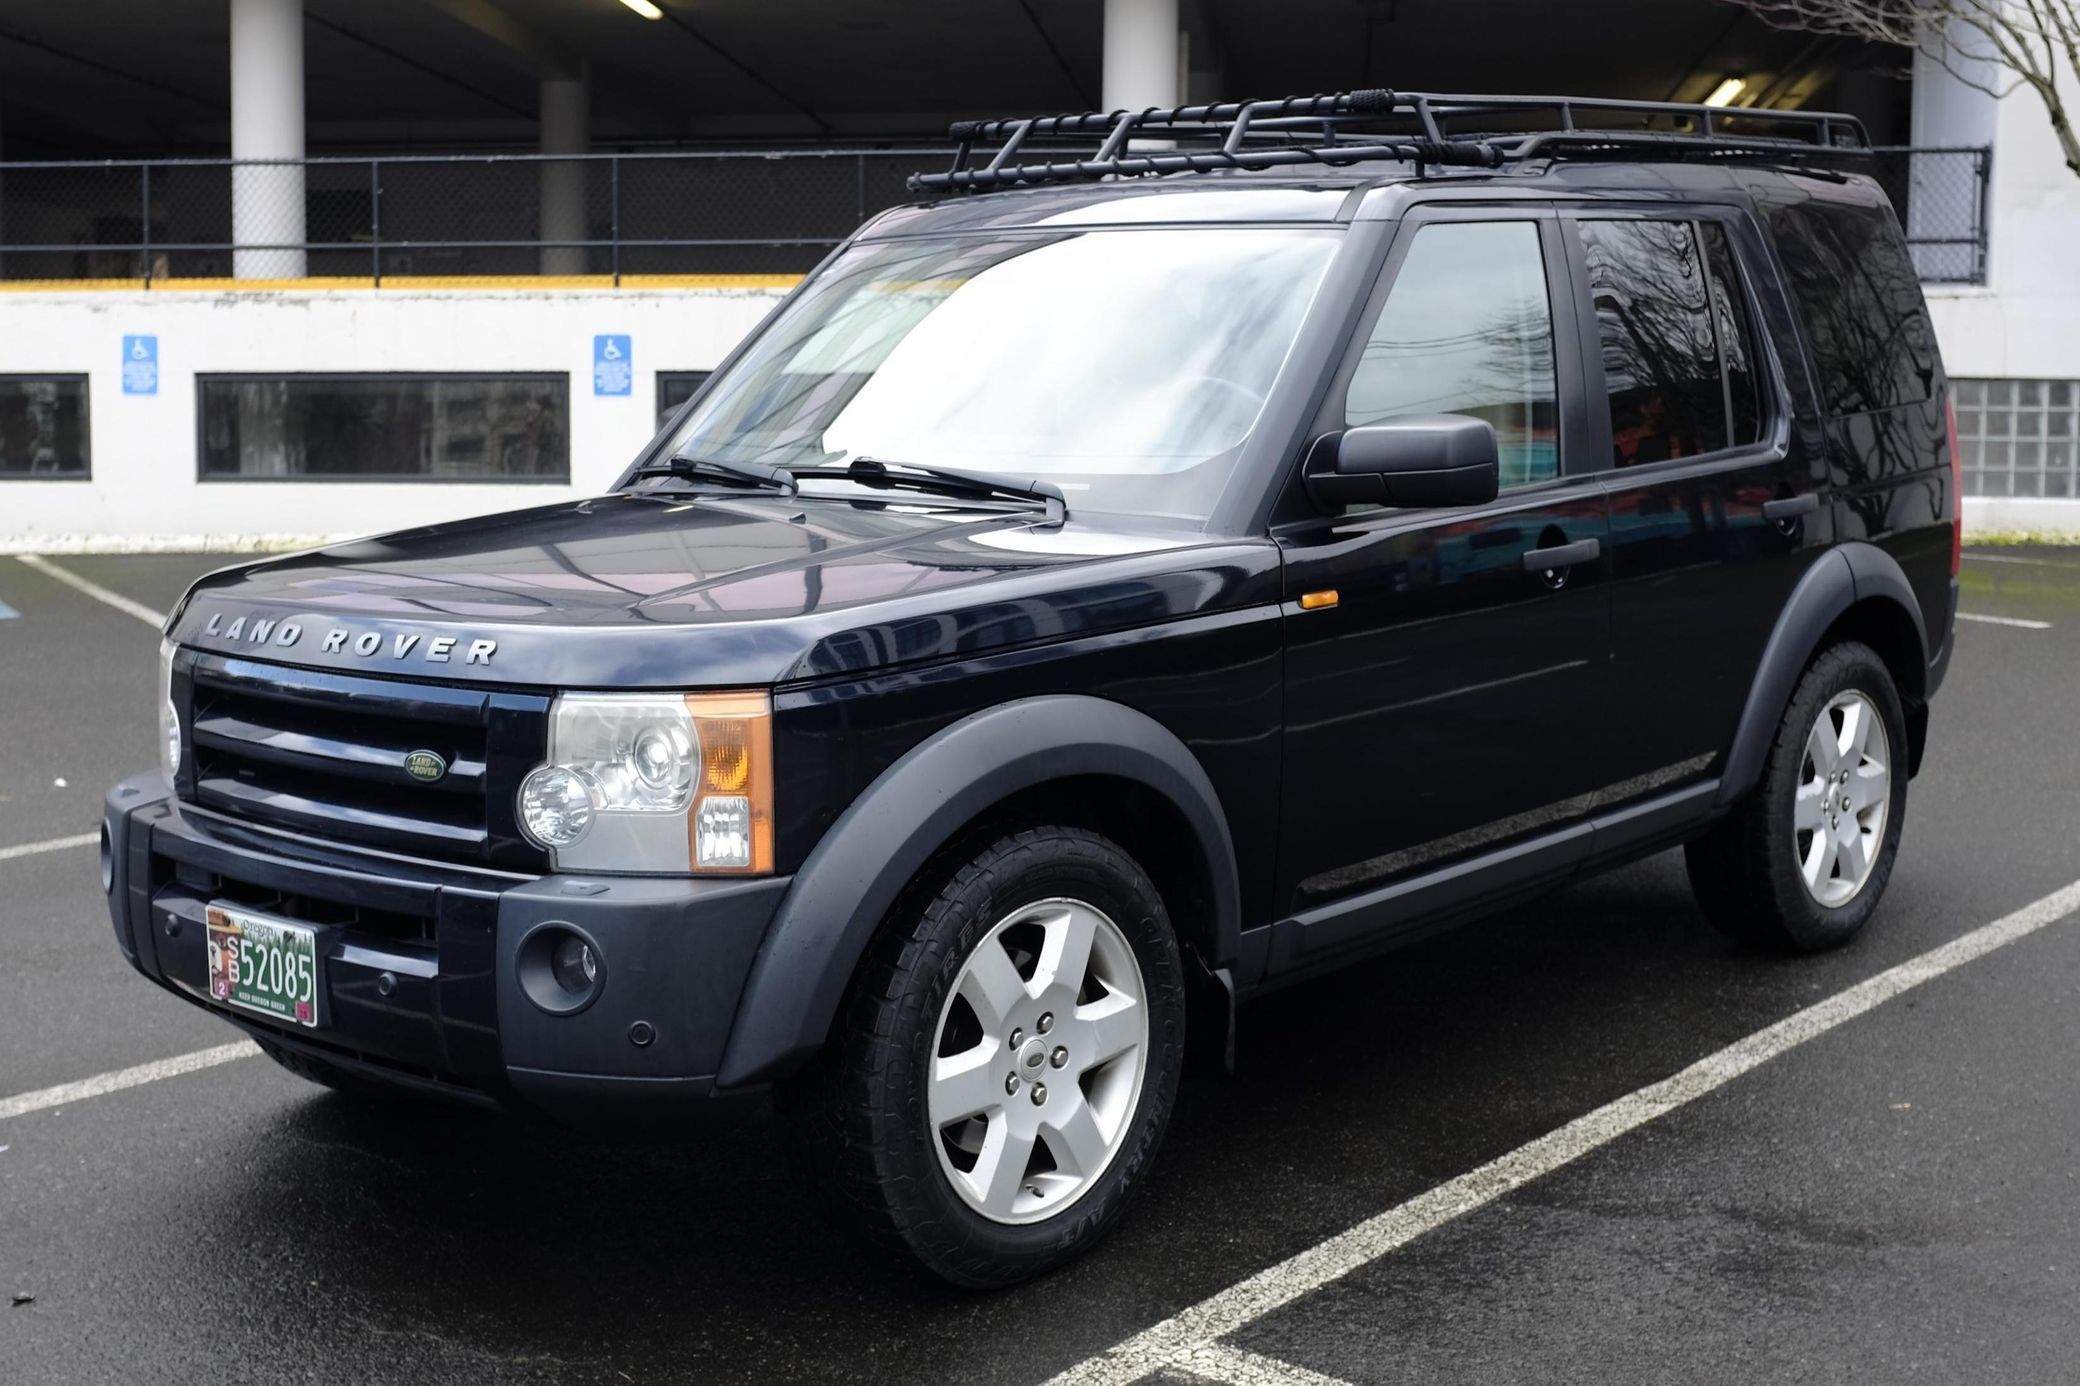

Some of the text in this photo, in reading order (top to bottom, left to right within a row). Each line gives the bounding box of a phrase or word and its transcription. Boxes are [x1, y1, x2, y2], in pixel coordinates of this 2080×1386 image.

[205, 613, 498, 665] LAND ROVER
[243, 919, 274, 938] Oregon
[240, 939, 312, 1002] 52085
[218, 982, 226, 995] 2
